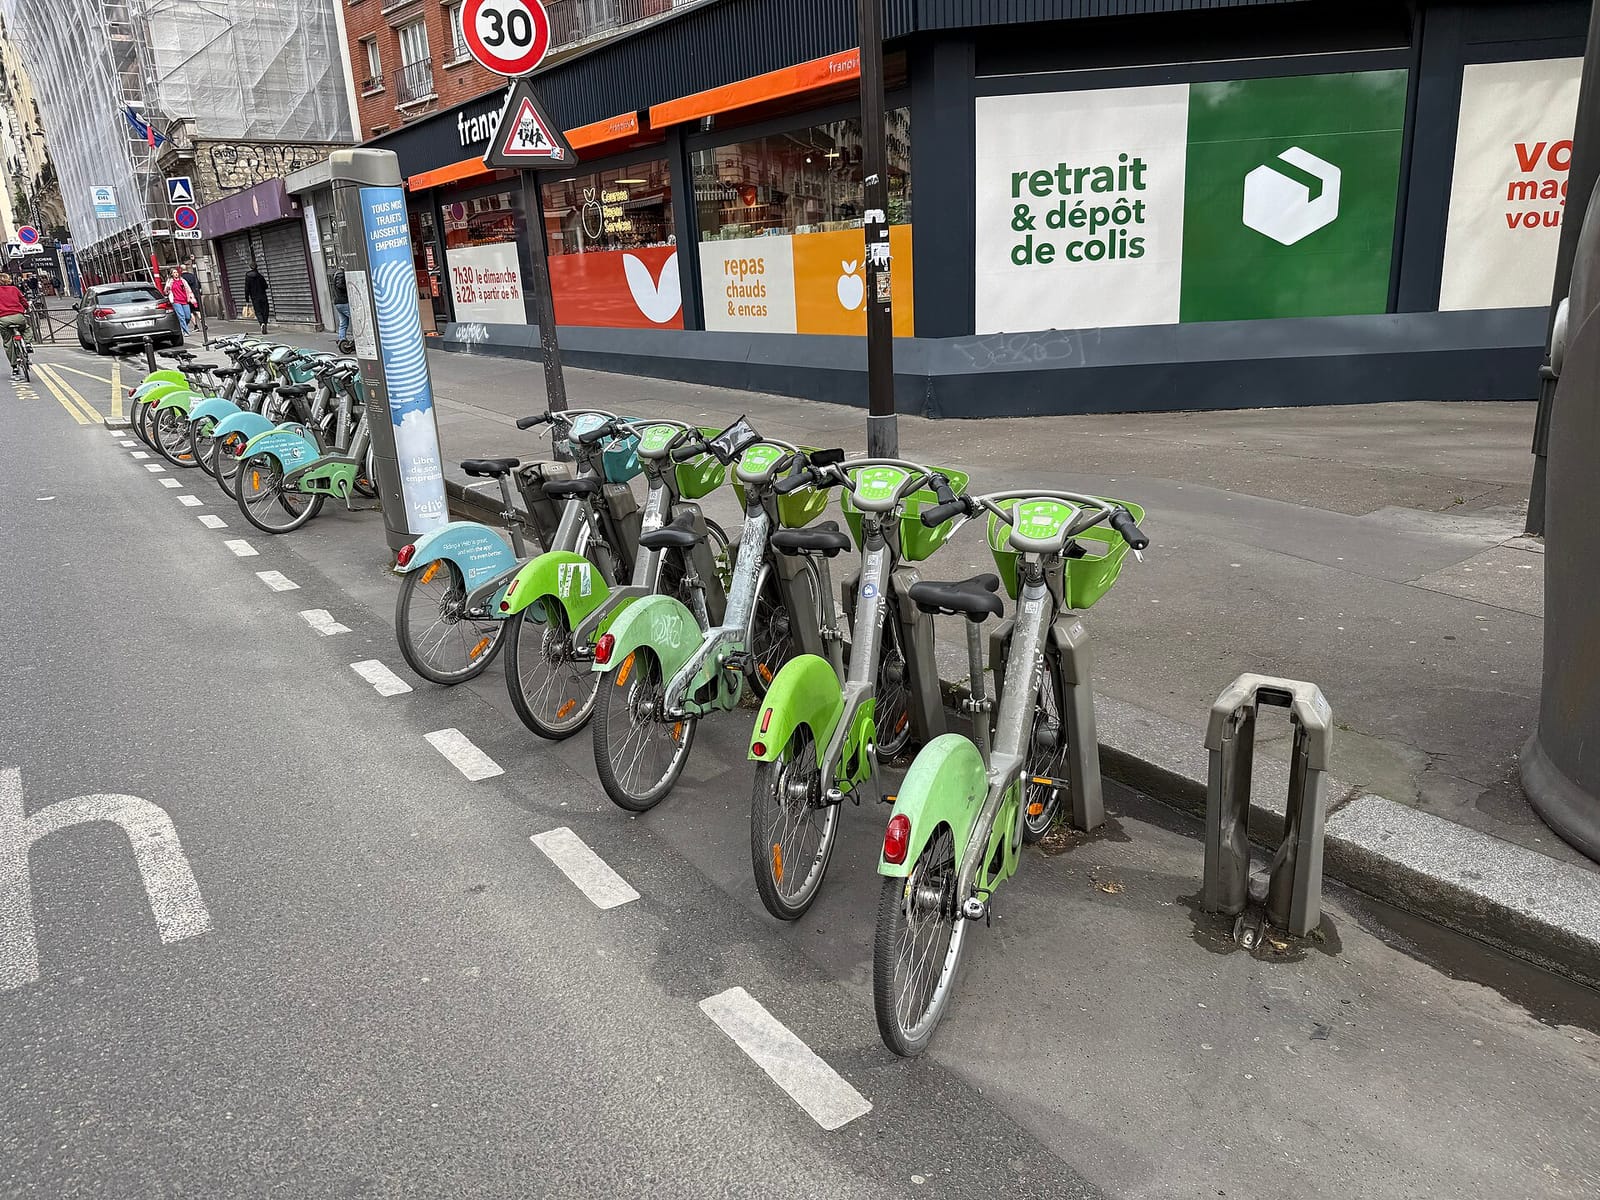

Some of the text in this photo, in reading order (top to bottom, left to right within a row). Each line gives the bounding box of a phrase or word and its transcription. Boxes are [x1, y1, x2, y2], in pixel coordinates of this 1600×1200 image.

[481, 8, 532, 47] 30
[1011, 153, 1147, 198] retrait
[371, 200, 403, 214] TOUS NOS
[376, 213, 402, 226] TRAJETS
[1011, 198, 1146, 235] & dépôt
[1505, 211, 1562, 229] vou
[370, 226, 399, 241] LAISSENT
[1011, 229, 1145, 265] de colis
[453, 266, 517, 284] 7h30 le dimanche
[724, 258, 765, 281] repas
[456, 285, 520, 303] à 22h à partir de 9h
[726, 279, 767, 298] chauds
[728, 300, 768, 317] & encas
[413, 456, 434, 465] Libre
[424, 465, 438, 473] son
